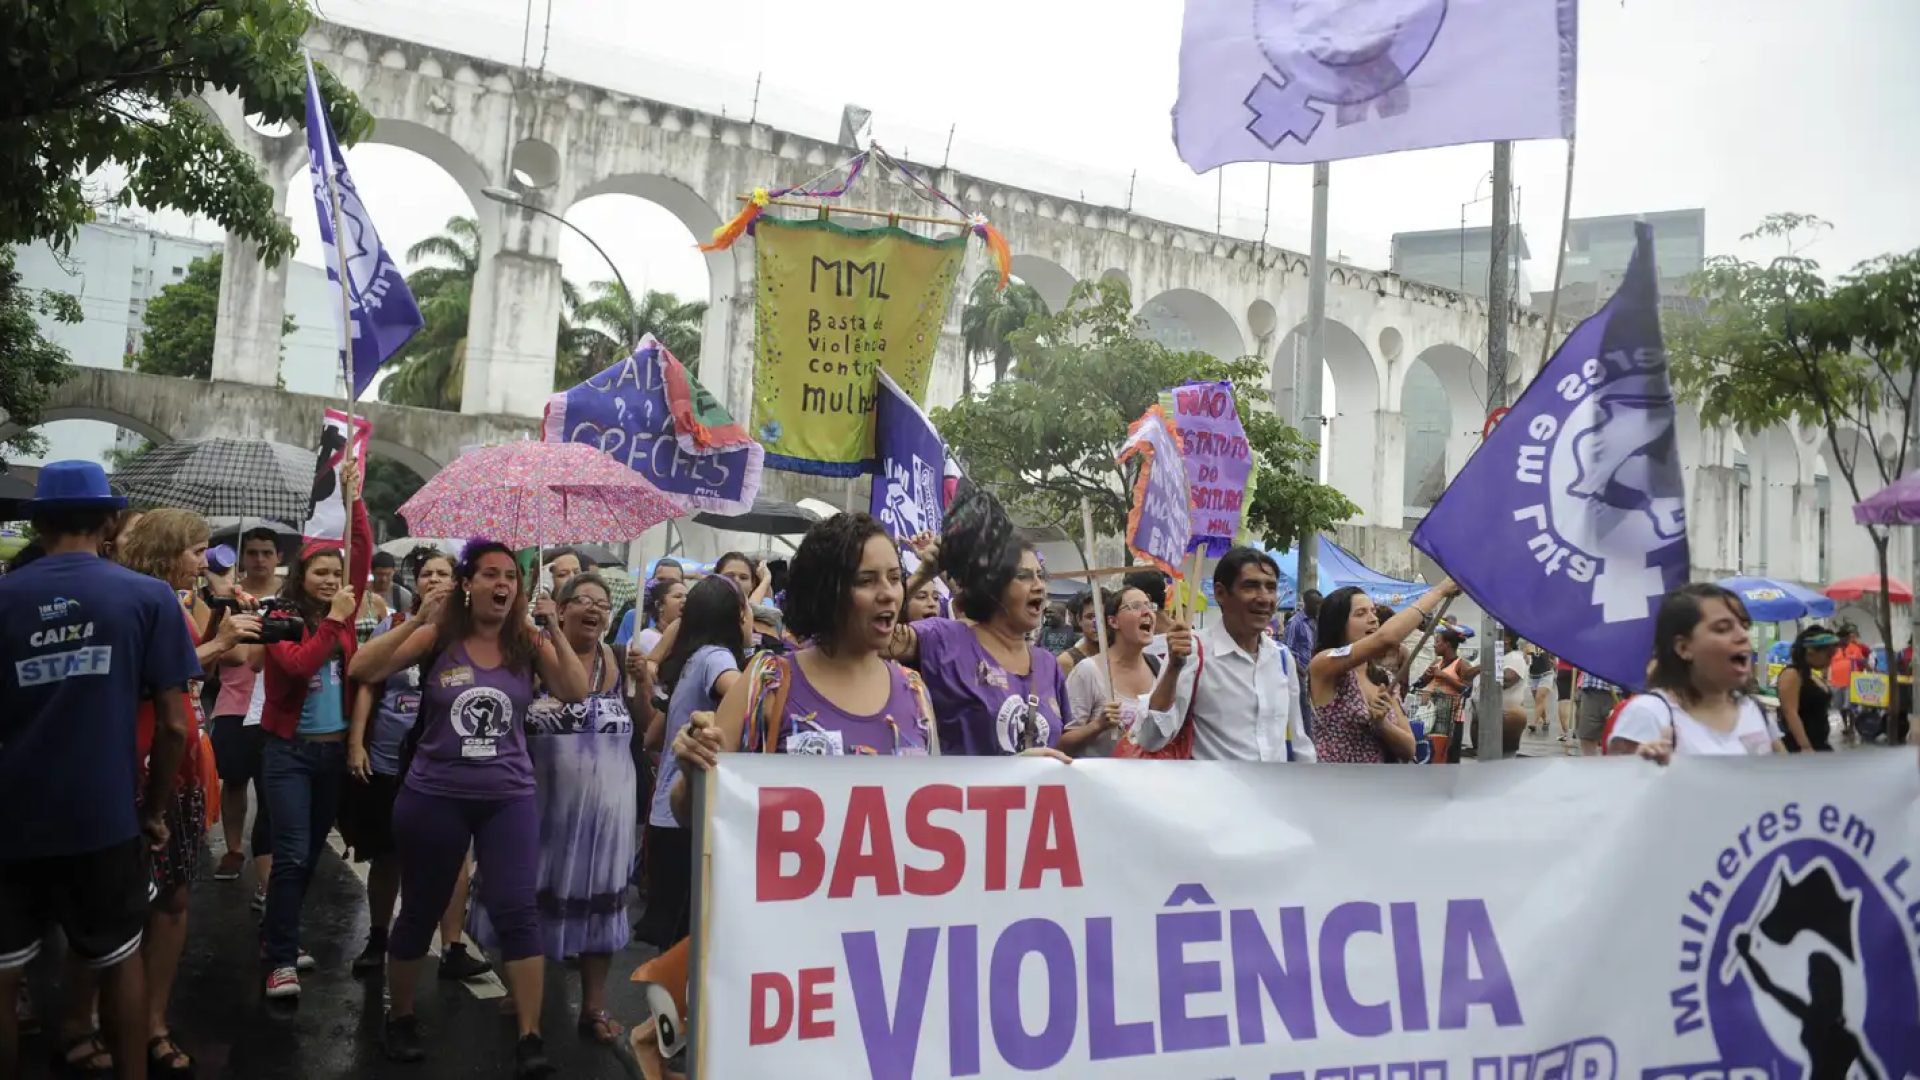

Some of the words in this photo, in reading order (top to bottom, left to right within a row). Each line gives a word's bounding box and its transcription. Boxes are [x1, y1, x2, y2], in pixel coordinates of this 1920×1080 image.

[810, 255, 890, 300] MML
[808, 308, 867, 334] Basta
[873, 314, 884, 331] de
[1198, 463, 1219, 483] DO
[694, 486, 721, 498] MML
[29, 621, 94, 648] CAIXA
[21, 652, 107, 681] STAFF
[756, 784, 1083, 902] BASTA
[1669, 801, 1802, 1036] Mulheres
[1818, 803, 1876, 858] em
[749, 966, 836, 1047] DE
[841, 883, 1525, 1080] VIOLÊNCIA
